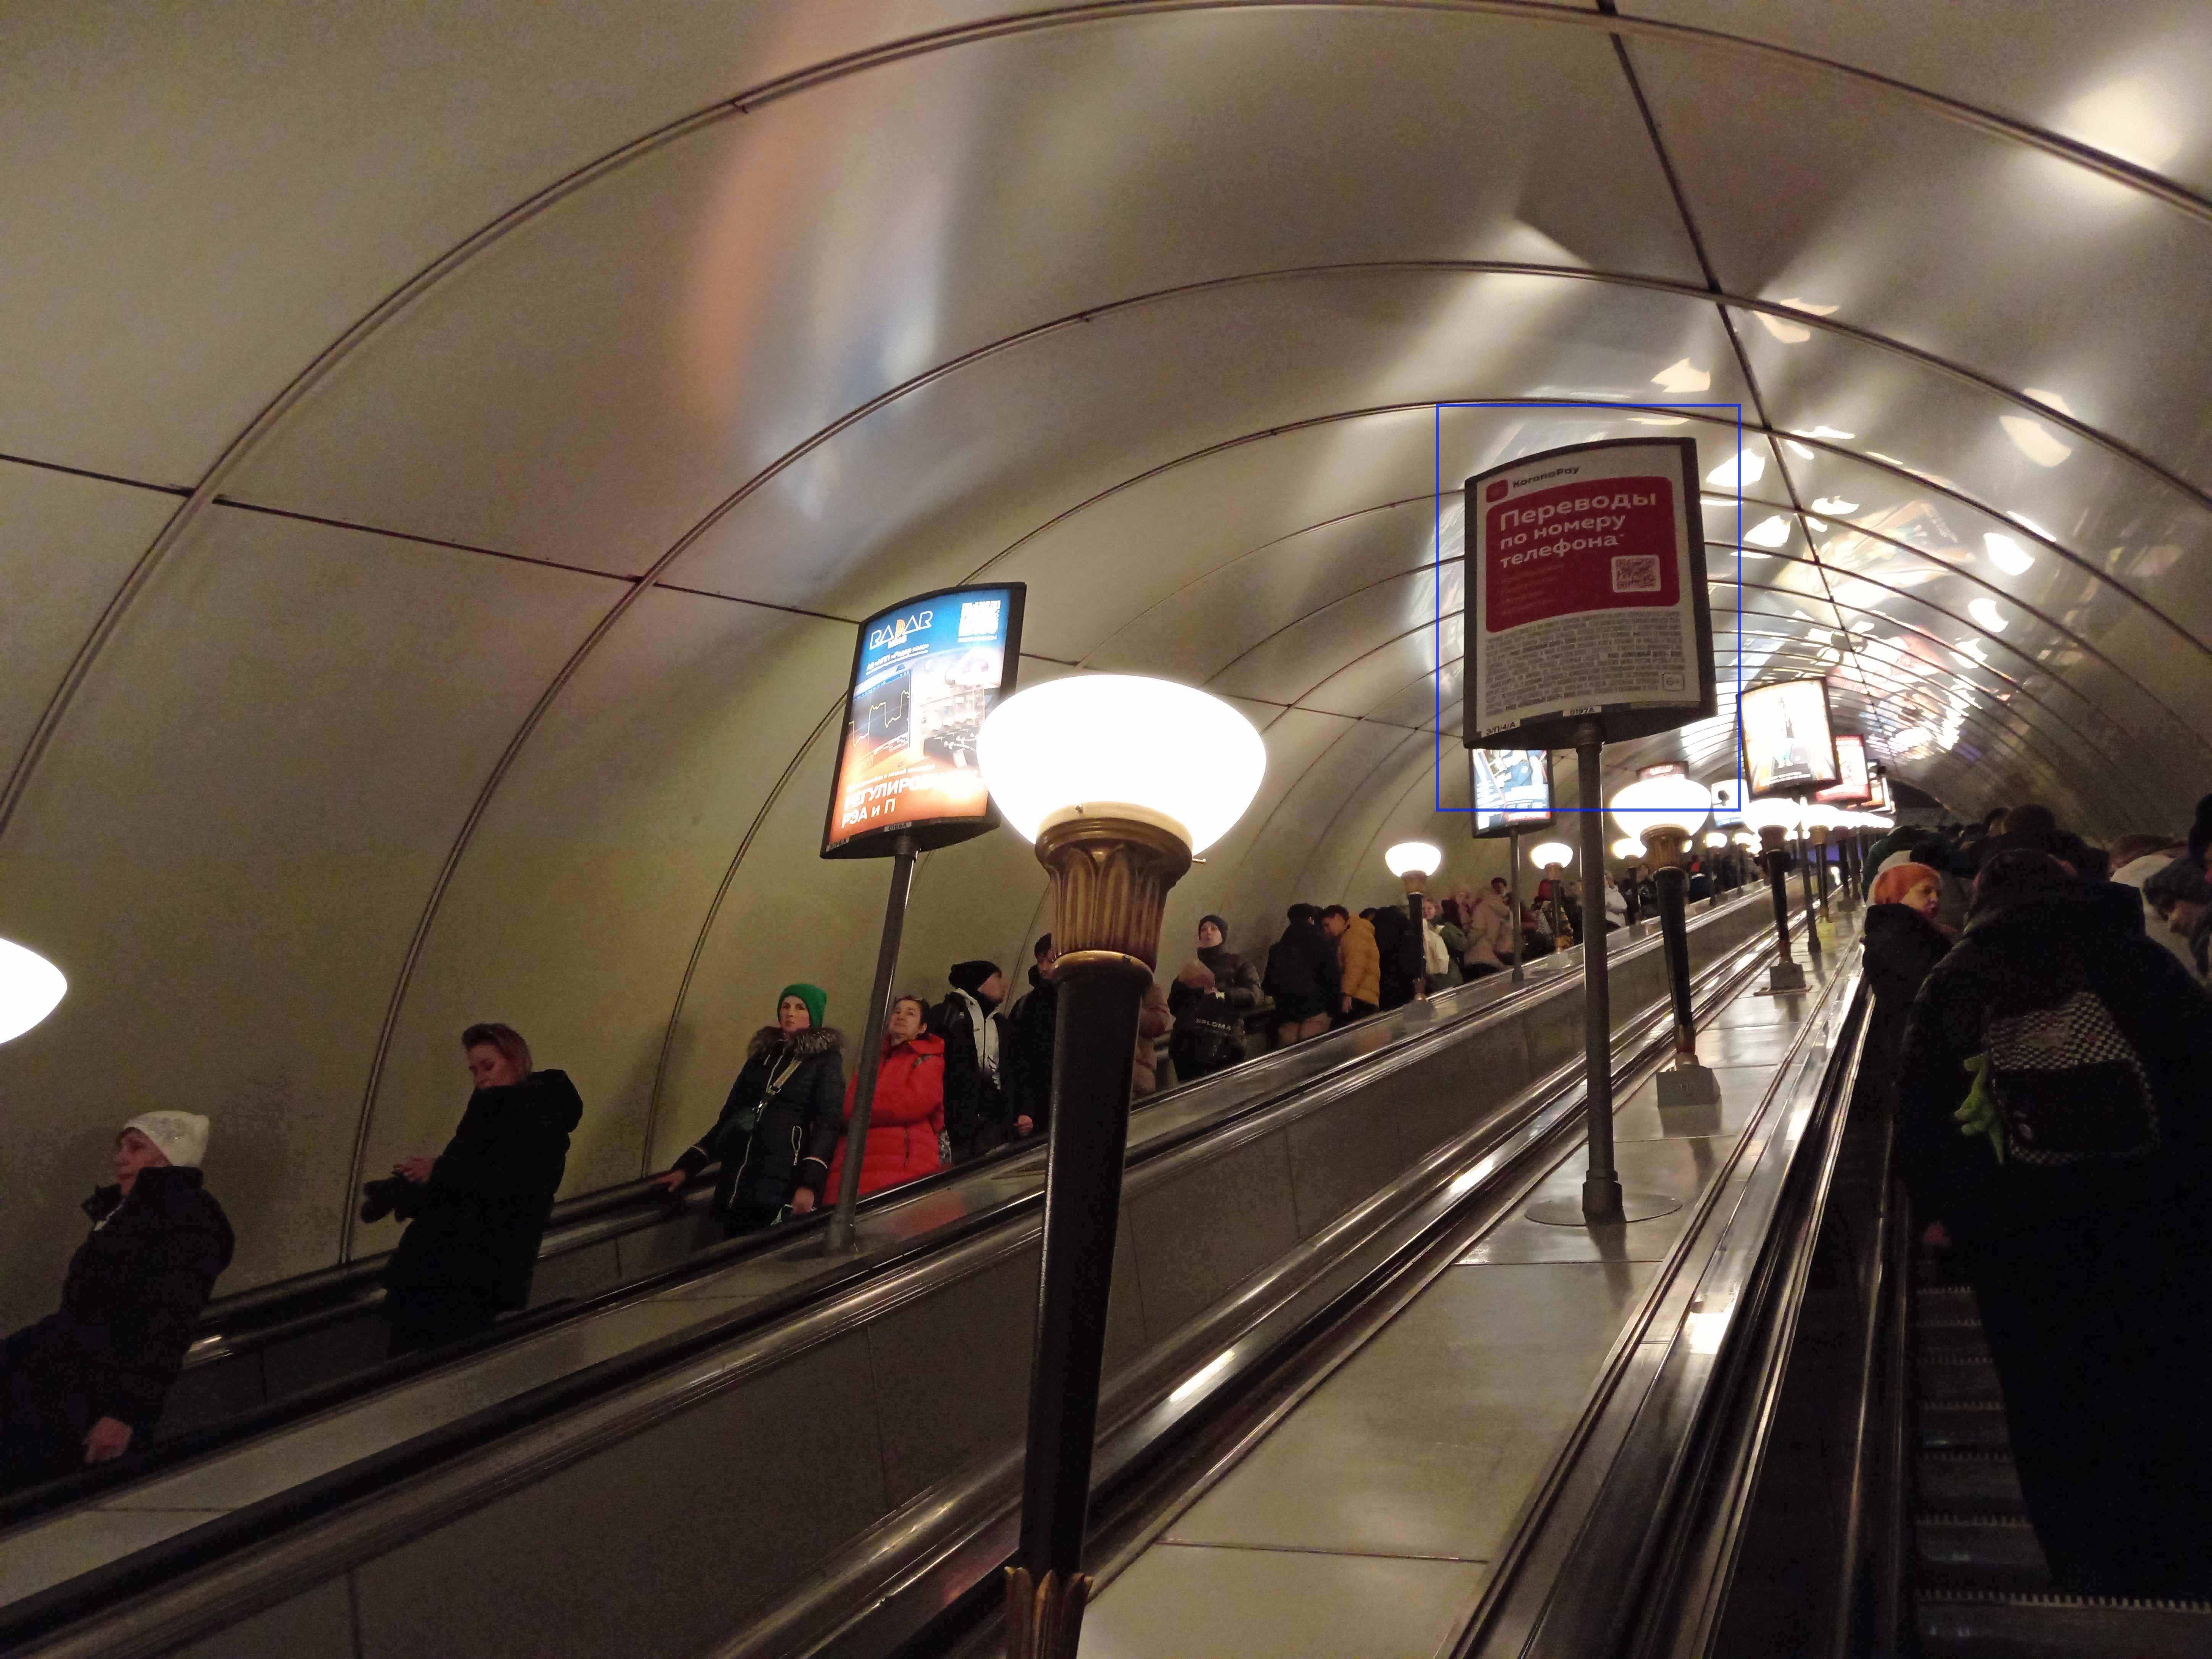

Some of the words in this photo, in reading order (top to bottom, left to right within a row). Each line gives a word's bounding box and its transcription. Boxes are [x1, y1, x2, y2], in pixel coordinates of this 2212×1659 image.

[1513, 466, 1580, 488] KoronaPay
[1501, 493, 1656, 531] Переводы
[1501, 532, 1527, 550] по
[1534, 514, 1626, 540] номеру
[869, 611, 933, 650] RADAR
[841, 807, 868, 829] РЭА
[871, 804, 880, 817] и
[884, 798, 896, 814] П
